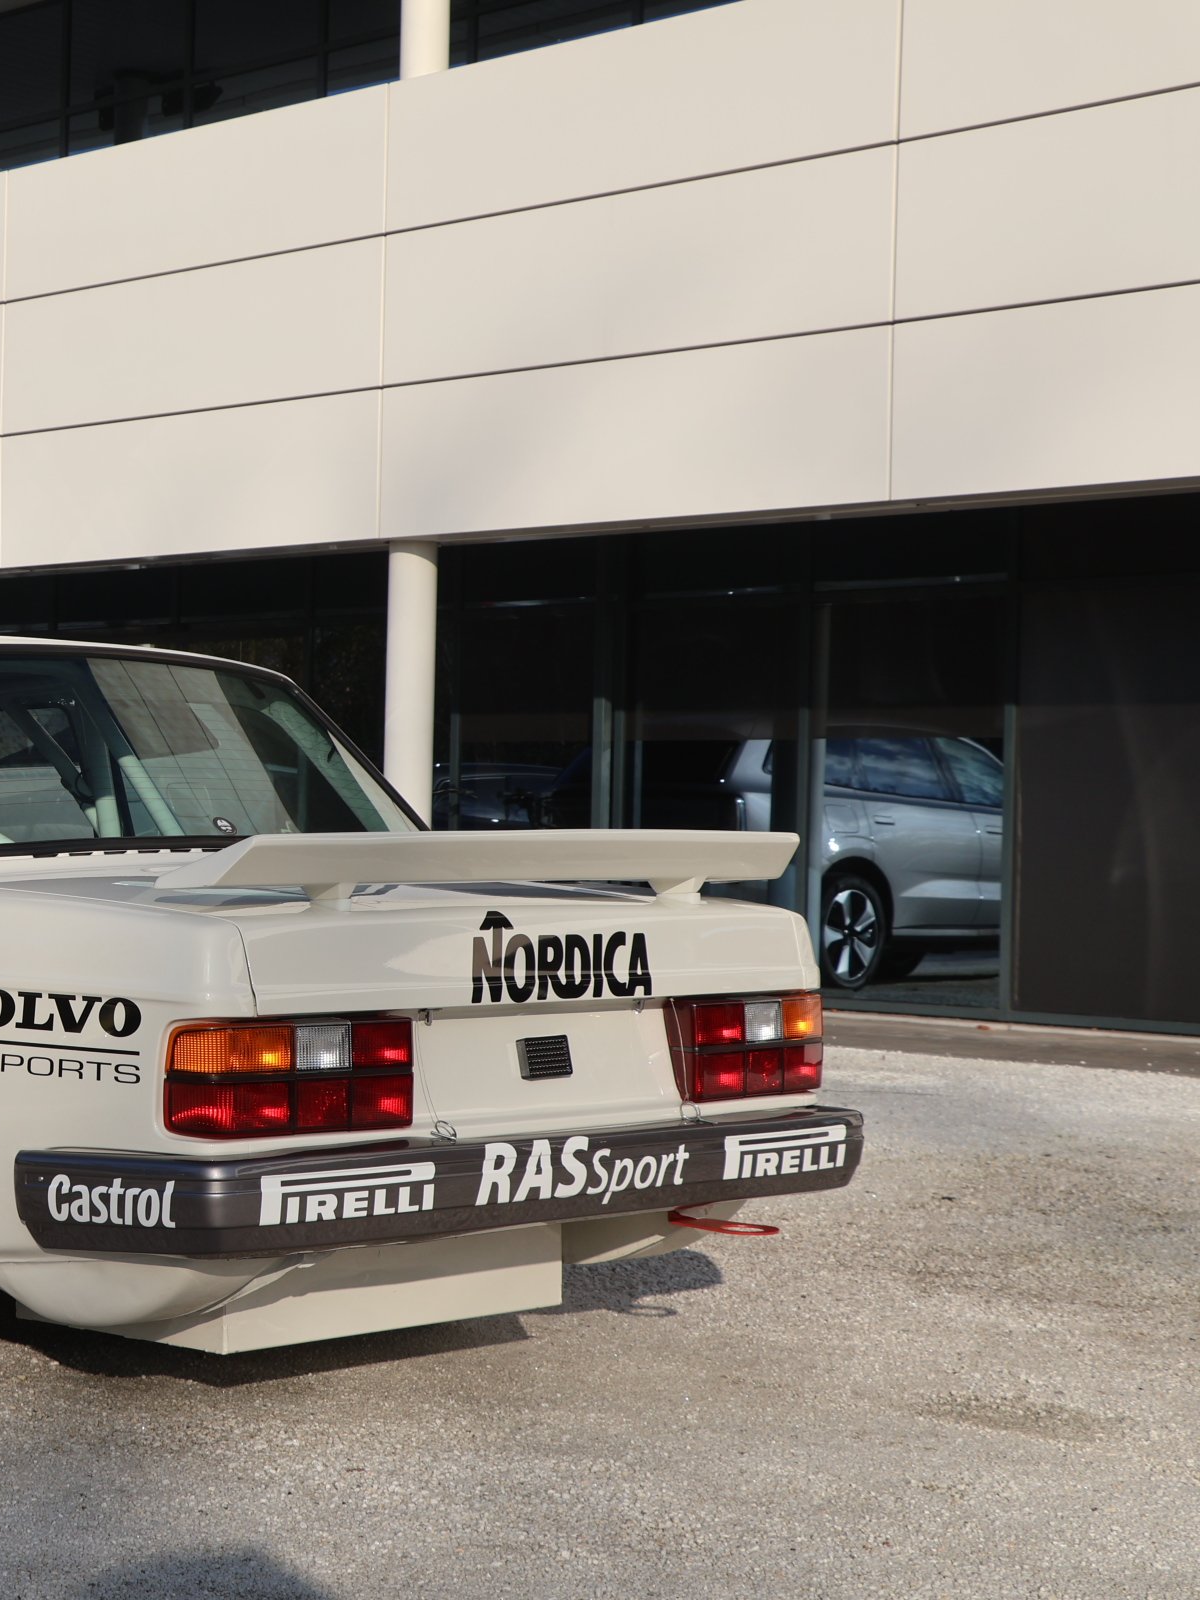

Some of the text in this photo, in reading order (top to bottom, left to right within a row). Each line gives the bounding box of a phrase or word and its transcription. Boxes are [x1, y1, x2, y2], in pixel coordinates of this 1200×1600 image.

[471, 911, 652, 1003] NORDICA
[723, 1124, 847, 1181] PIRELLI
[47, 1173, 176, 1229] Castrol
[259, 1161, 436, 1226] PIRELLI
